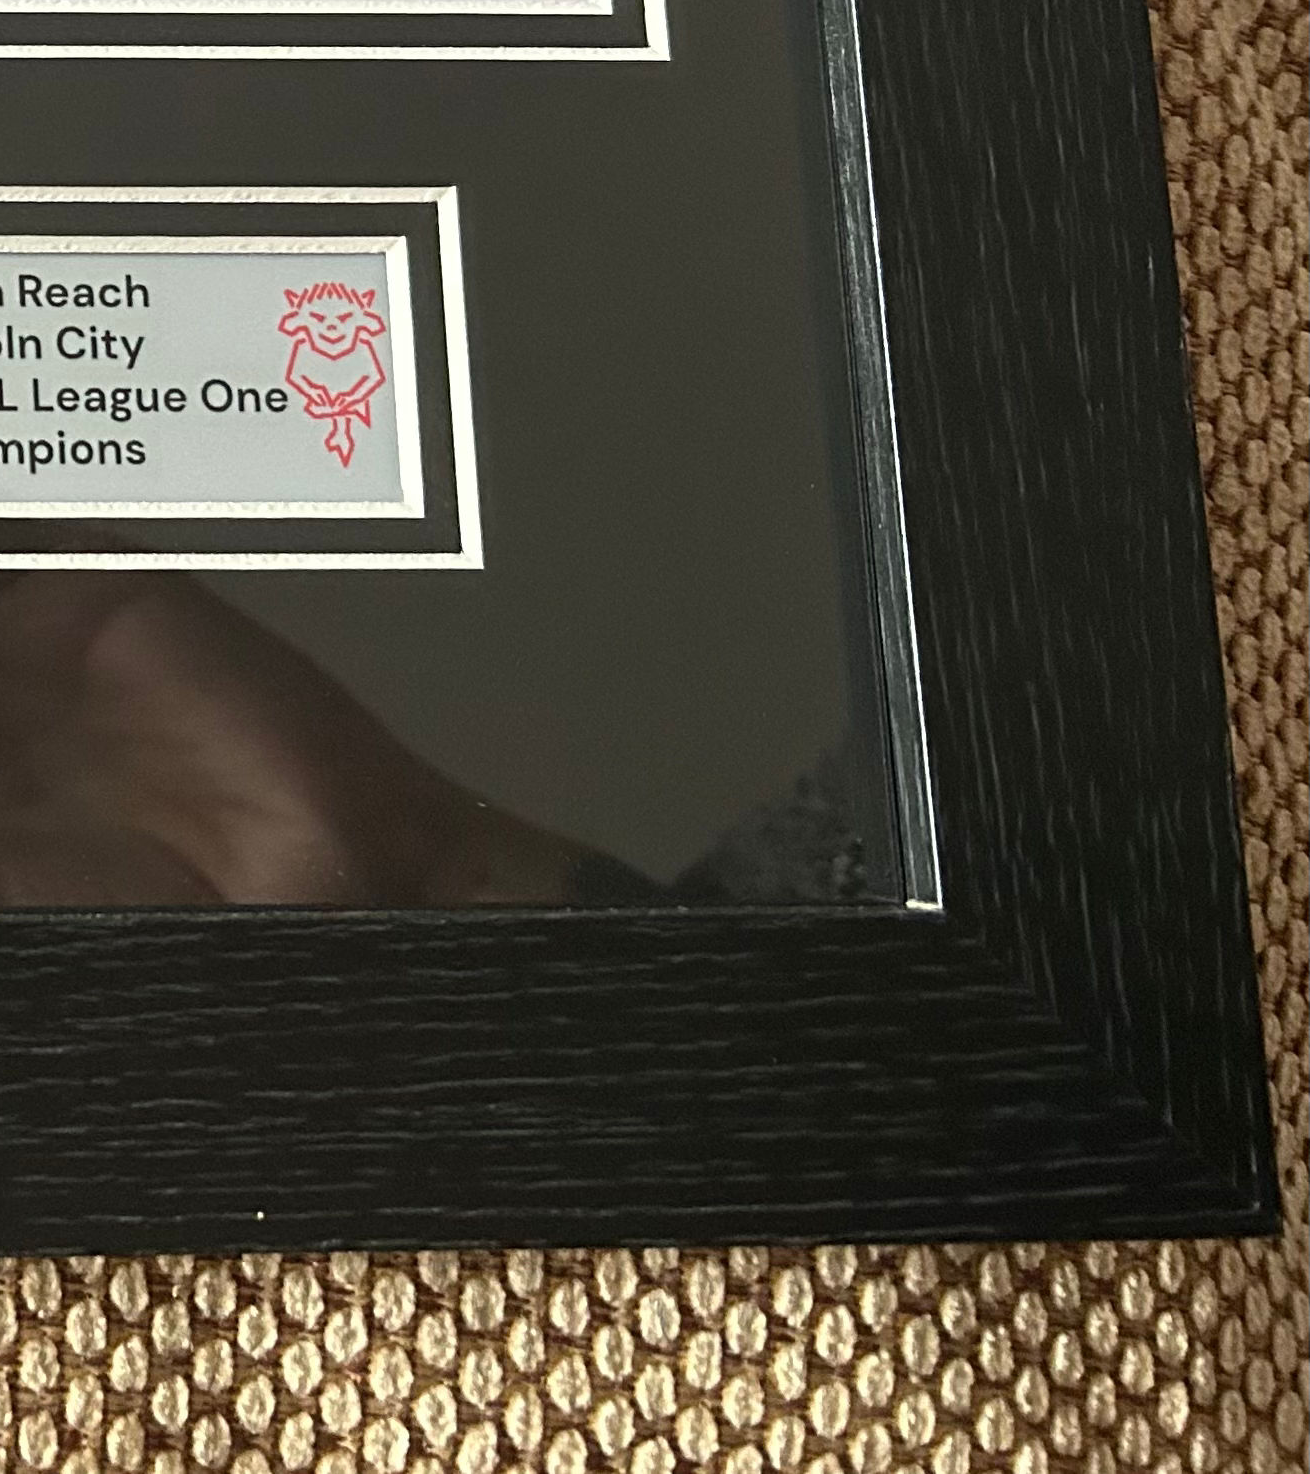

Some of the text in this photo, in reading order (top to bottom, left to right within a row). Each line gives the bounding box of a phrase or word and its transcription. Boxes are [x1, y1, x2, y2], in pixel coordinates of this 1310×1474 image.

[18, 274, 150, 308] Reach
[56, 326, 145, 370] City
[32, 378, 187, 423] League
[201, 379, 288, 413] One
